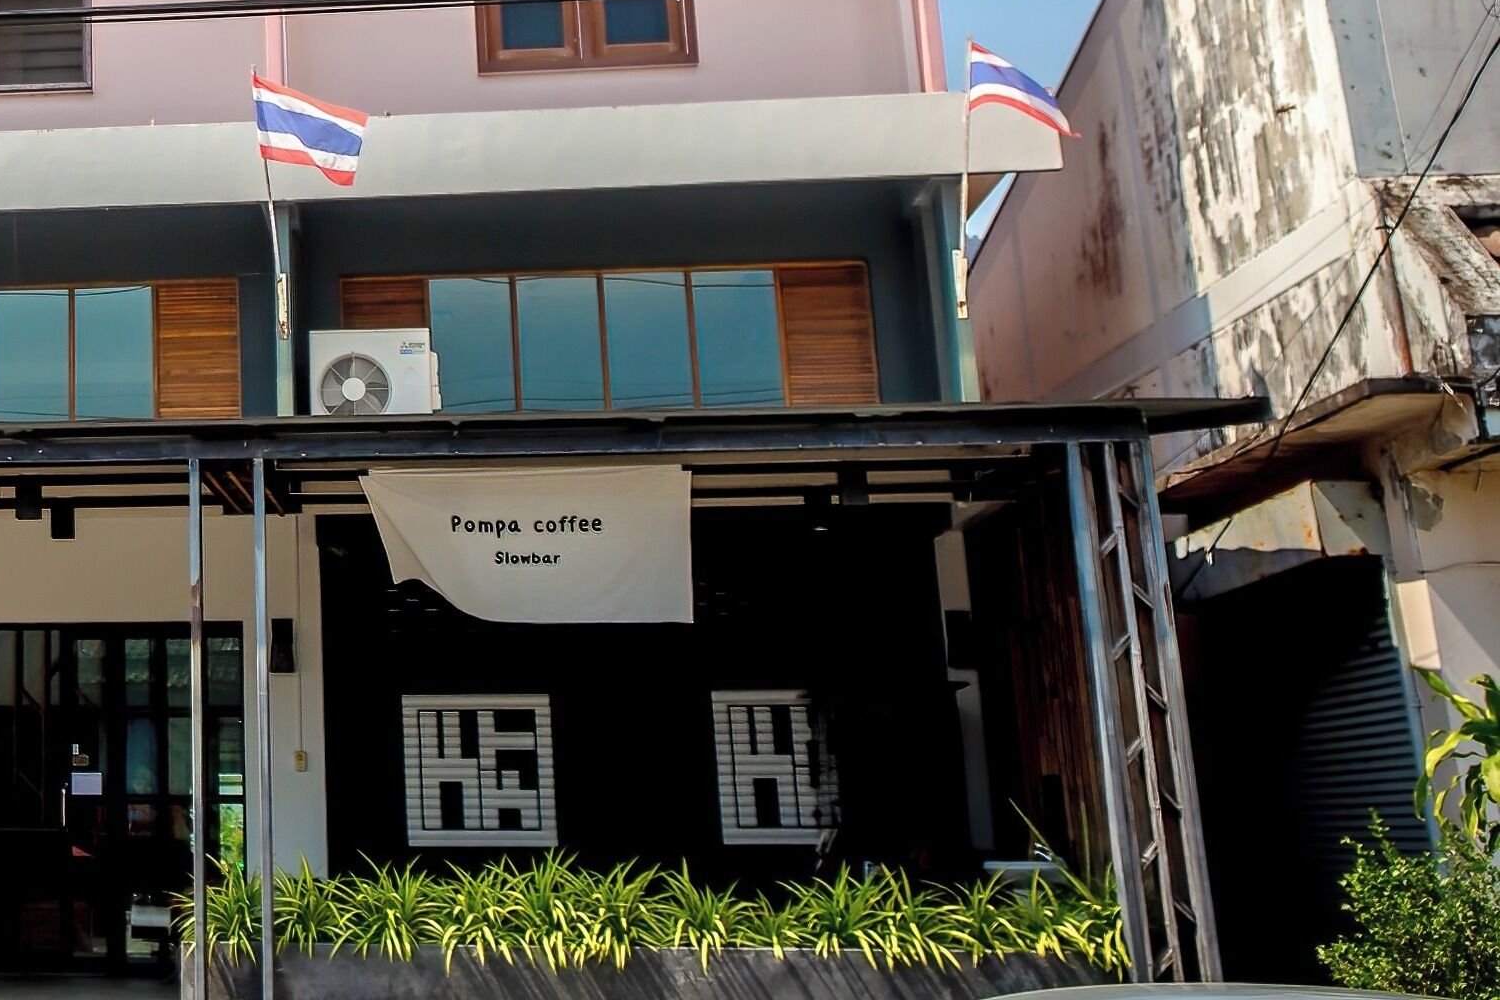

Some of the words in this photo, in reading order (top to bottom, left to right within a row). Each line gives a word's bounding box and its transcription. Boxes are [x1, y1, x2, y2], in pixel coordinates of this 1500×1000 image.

[451, 515, 521, 538] Pompa
[533, 515, 603, 533] coffee
[494, 551, 561, 565] Slowbar
